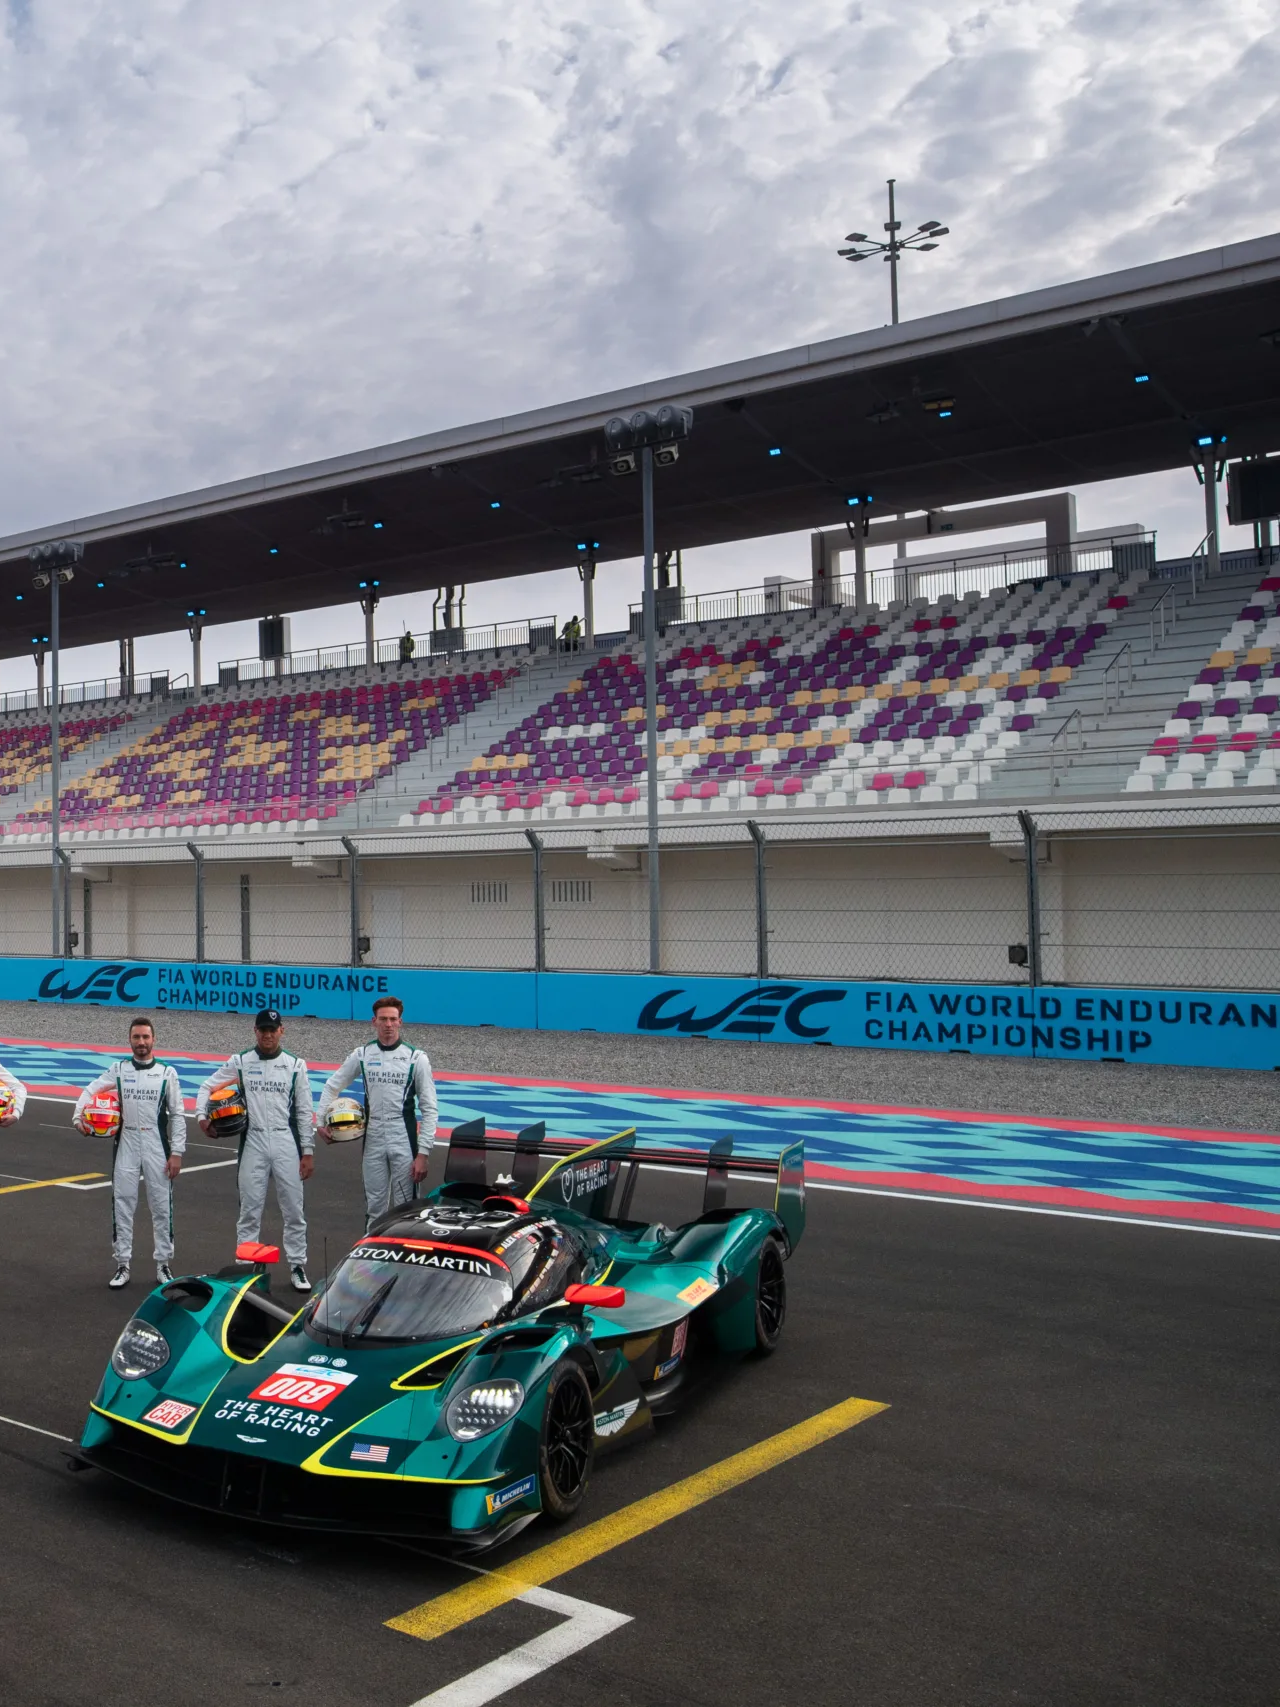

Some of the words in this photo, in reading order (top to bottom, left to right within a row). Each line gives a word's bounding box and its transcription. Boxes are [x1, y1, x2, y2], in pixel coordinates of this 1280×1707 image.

[39, 964, 149, 1003] WEC
[158, 968, 185, 984] FIA
[192, 970, 256, 988] WORLD
[263, 972, 388, 993] ENDURANCE
[158, 988, 301, 1010] CHAMPIONSHIP
[637, 985, 848, 1037] WEC
[866, 991, 918, 1013] FIA
[928, 993, 1062, 1019] WORLD
[1076, 998, 1277, 1028] ENDURAN
[866, 1019, 1152, 1053] CHAMPIONSHIP
[576, 1167, 588, 1182] THE
[589, 1159, 607, 1177] HEART
[577, 1183, 585, 1196] OF
[586, 1174, 607, 1193] RACING
[405, 1253, 491, 1276] MARTIN
[259, 1378, 336, 1404] 009
[149, 1408, 182, 1426] CAR
[160, 1402, 191, 1415] HYPER
[223, 1399, 261, 1412] THE
[264, 1406, 333, 1427] HEART
[597, 1416, 610, 1425] ASTON
[610, 1411, 624, 1421] MARTIN
[214, 1410, 241, 1420] OF
[244, 1414, 320, 1437] RACING
[501, 1482, 530, 1502] MICHELIN
